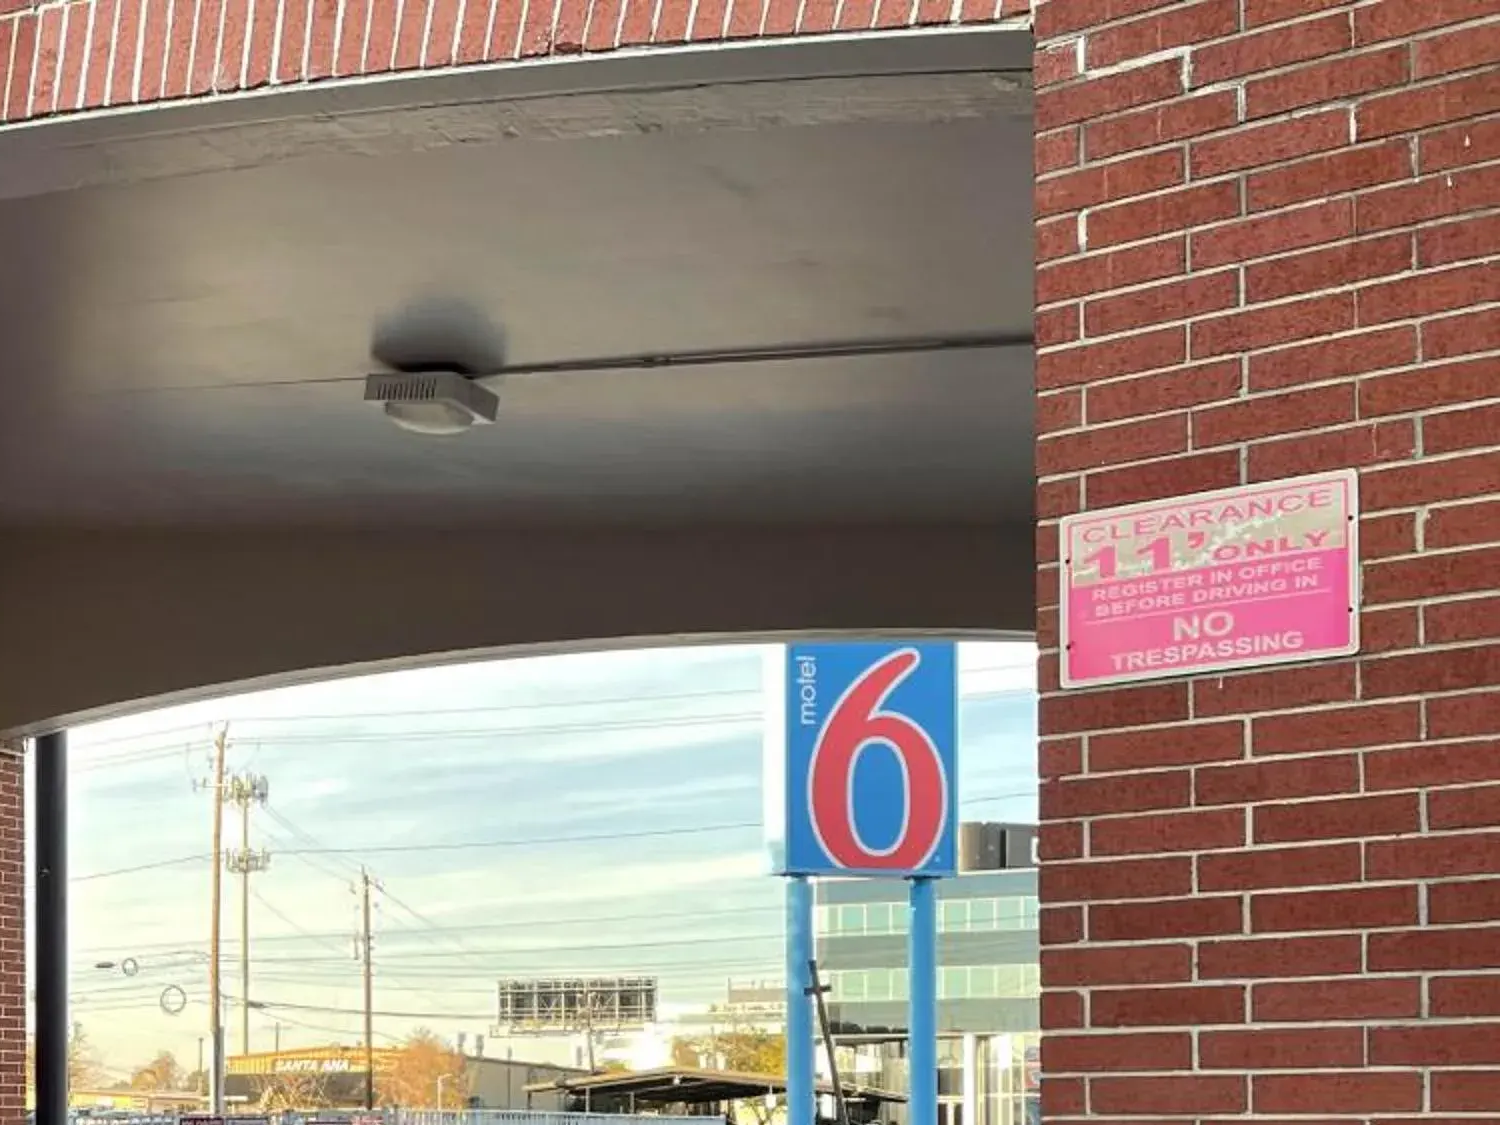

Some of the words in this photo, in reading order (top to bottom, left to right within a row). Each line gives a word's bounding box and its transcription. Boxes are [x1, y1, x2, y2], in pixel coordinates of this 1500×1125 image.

[1082, 487, 1333, 544] CLEARANCE
[1211, 530, 1330, 562] ONLY
[1092, 574, 1203, 602] REGISTER
[1210, 569, 1233, 585] IN
[1239, 557, 1323, 579] OFFICE
[1095, 589, 1186, 617] BEFORE
[1193, 578, 1288, 601] DRIVING
[1295, 574, 1318, 589] IN
[1172, 611, 1234, 641] NO
[1111, 631, 1304, 672] TRESPASSING
[796, 656, 817, 725] motel
[807, 647, 948, 870] 6
[275, 1059, 318, 1072] SANTA
